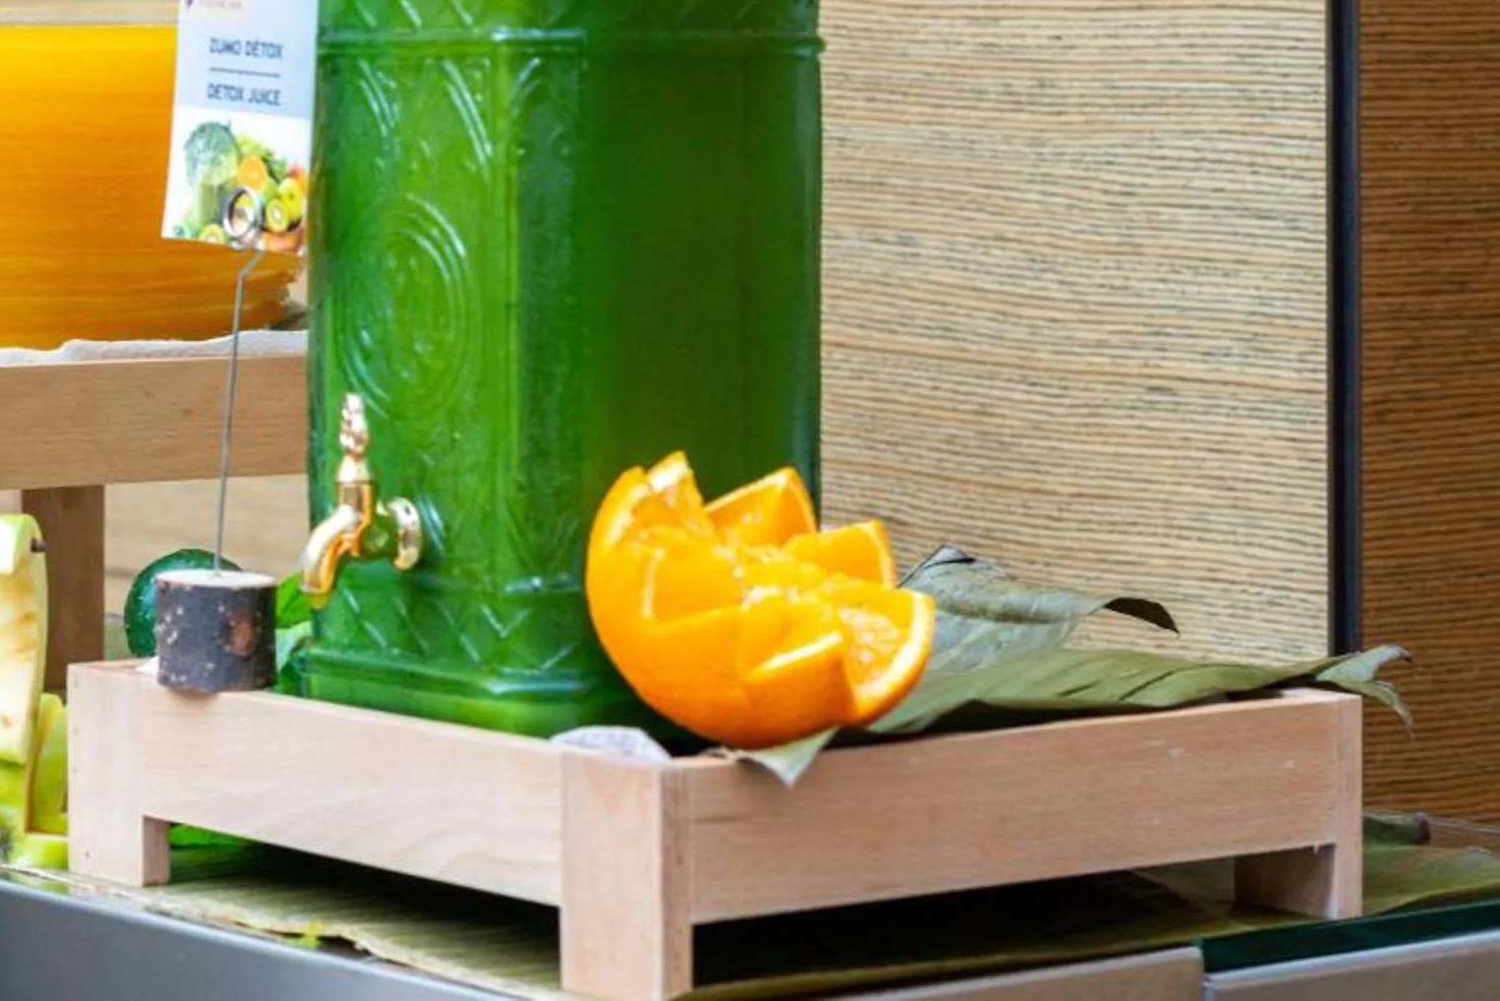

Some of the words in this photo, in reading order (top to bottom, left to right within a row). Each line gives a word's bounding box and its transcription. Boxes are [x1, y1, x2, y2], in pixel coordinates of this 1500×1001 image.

[209, 37, 241, 56] ZUMO
[207, 82, 244, 102] DETOX
[248, 88, 281, 106] JUICE
